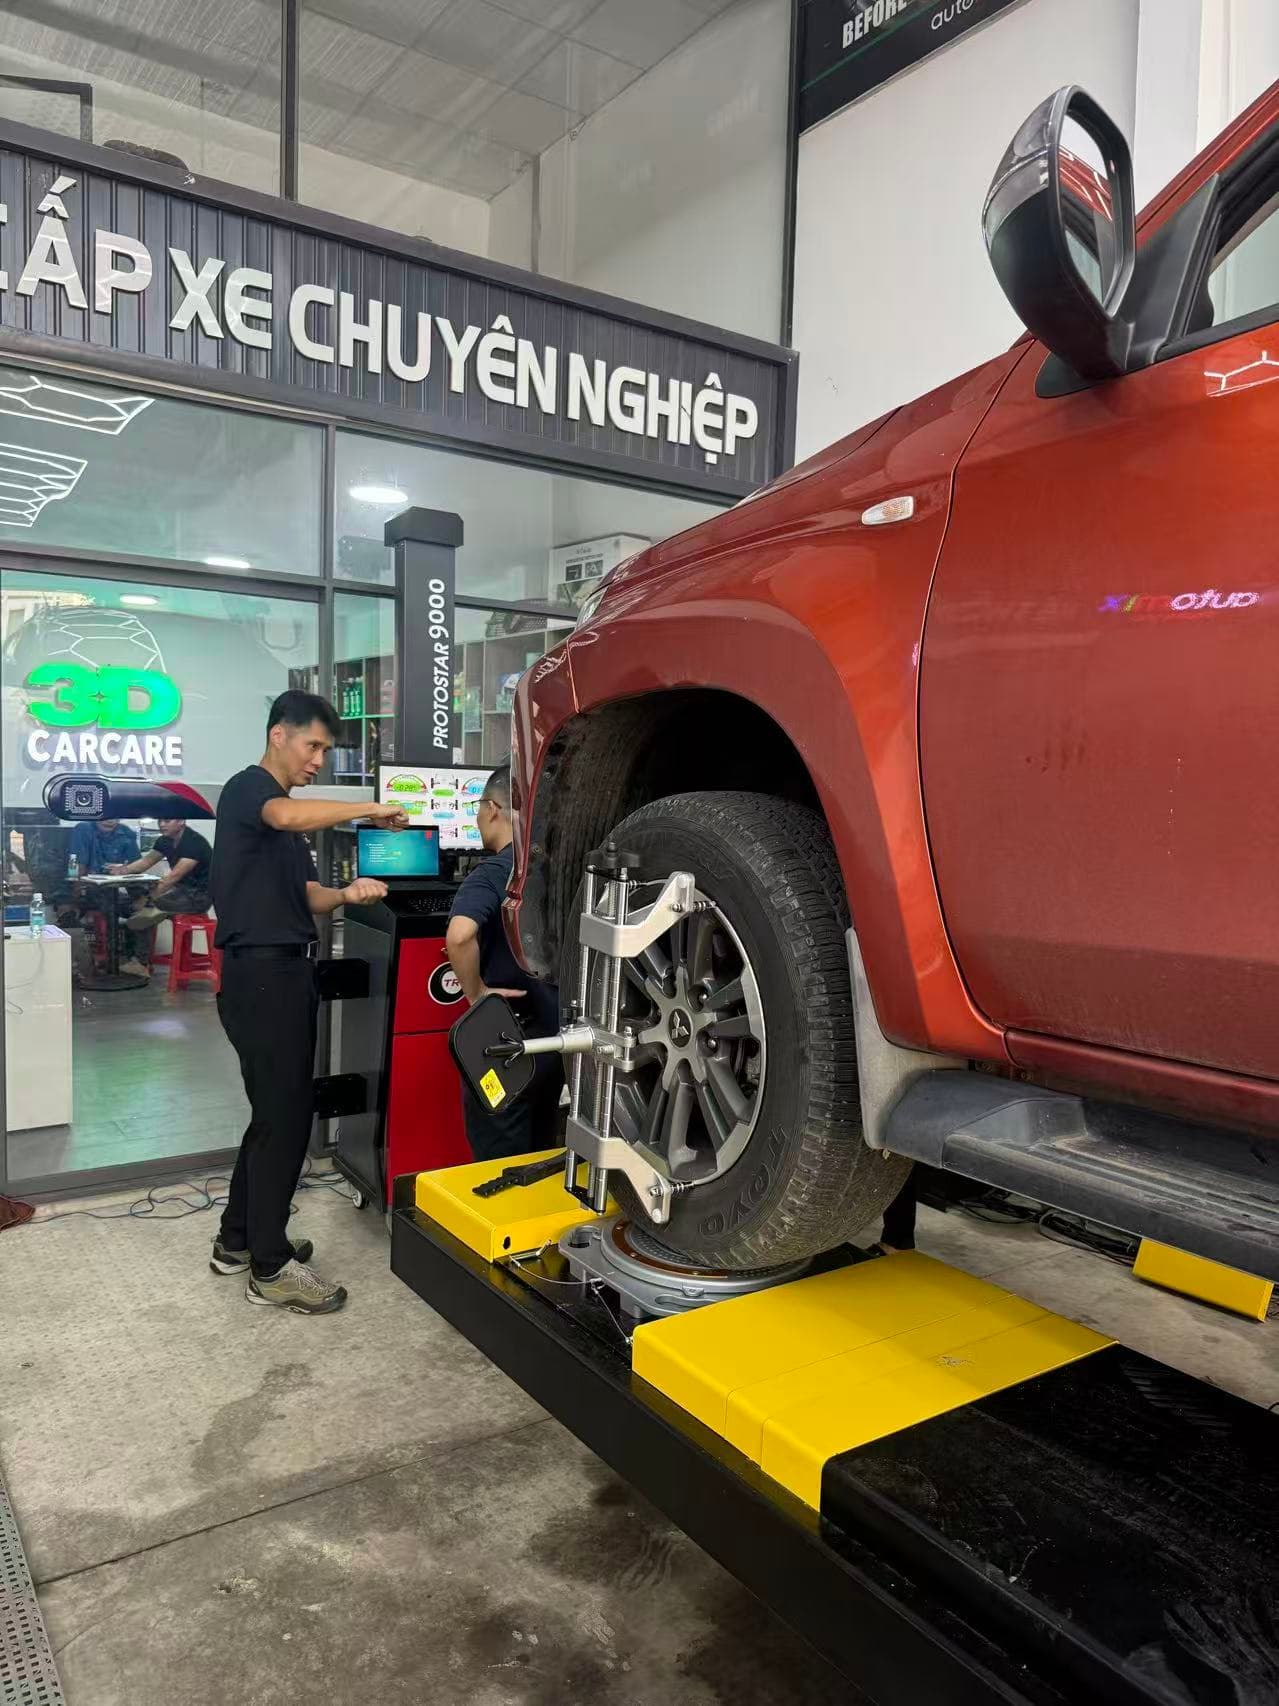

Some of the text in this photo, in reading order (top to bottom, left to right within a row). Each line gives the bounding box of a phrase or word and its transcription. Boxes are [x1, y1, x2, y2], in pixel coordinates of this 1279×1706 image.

[0, 175, 759, 465] ẤP XE CHUYÊN NGHIỆP
[26, 663, 182, 729] 3D
[428, 578, 450, 750] PROTOSTAR 9000
[27, 730, 183, 766] CARCARE
